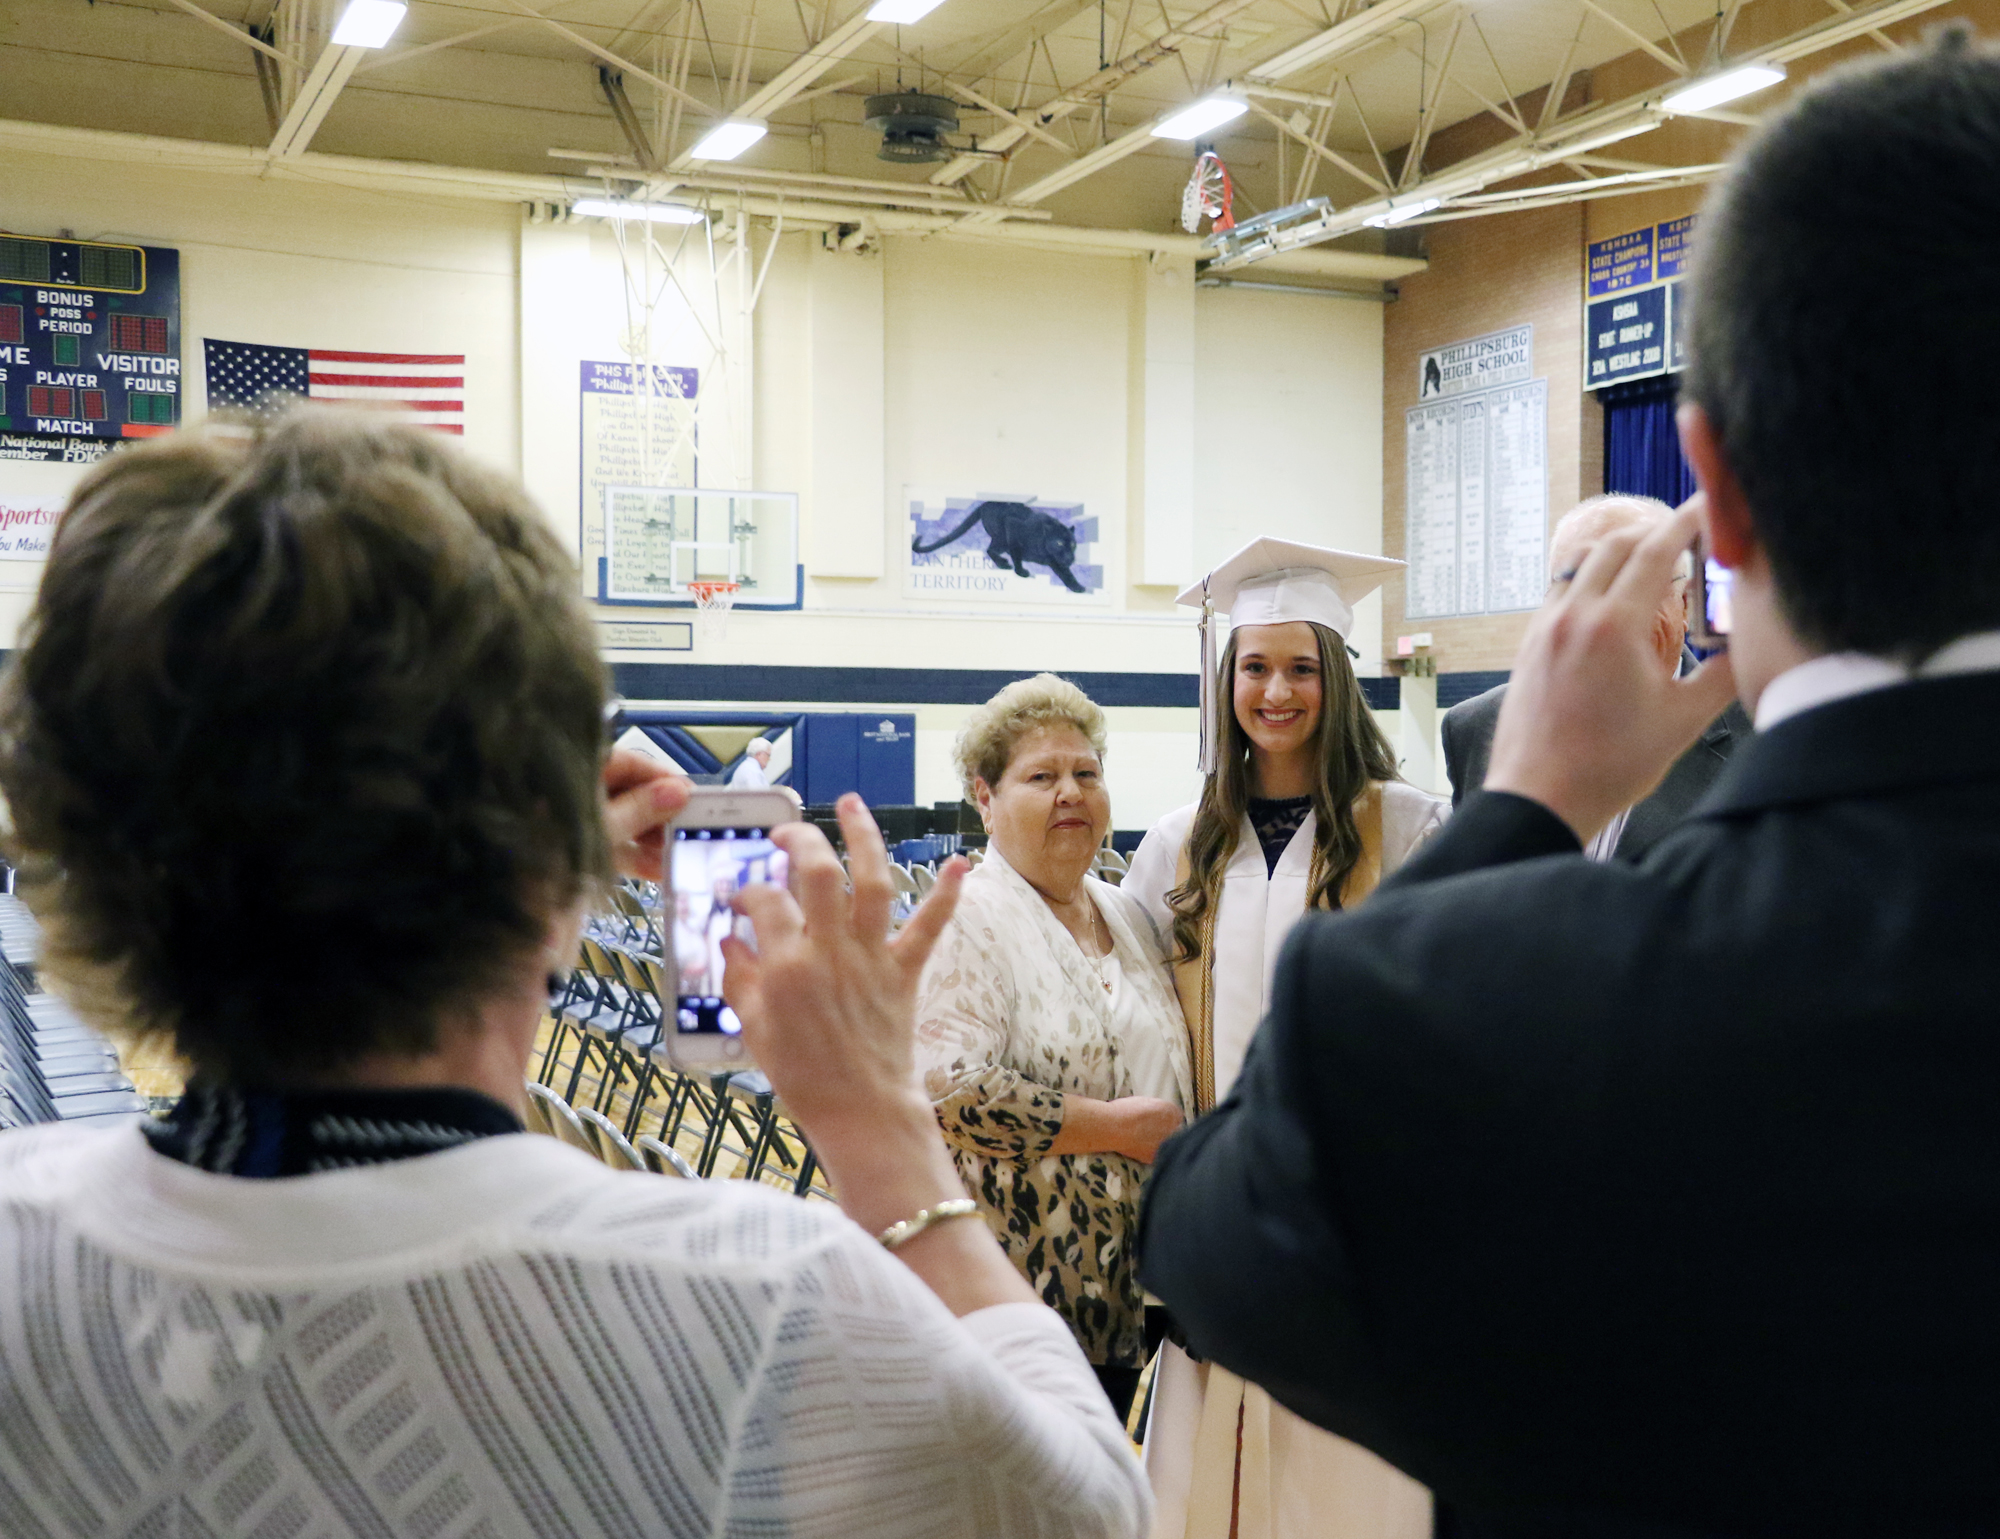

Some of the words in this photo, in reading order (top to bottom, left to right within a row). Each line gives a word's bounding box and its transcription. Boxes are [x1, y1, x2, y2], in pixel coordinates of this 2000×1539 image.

[37, 290, 94, 307] BONUS
[51, 307, 82, 319] POSS
[39, 320, 93, 334] PERIOD
[1441, 331, 1528, 366] PHILLIPSBURG
[97, 353, 180, 375] VISITOR
[1443, 362, 1473, 381] HIGH
[1478, 349, 1527, 373] SCHOOL
[36, 371, 98, 388] PLAYER
[594, 364, 623, 377] PHS
[656, 369, 683, 384] Sng
[124, 377, 177, 393] FOULS
[37, 419, 94, 435] MATCH
[1, 434, 66, 449] National
[68, 438, 107, 451] Bank
[62, 449, 104, 463] FDIC
[16, 537, 46, 551] Make
[910, 573, 1007, 591] TERRITORY
